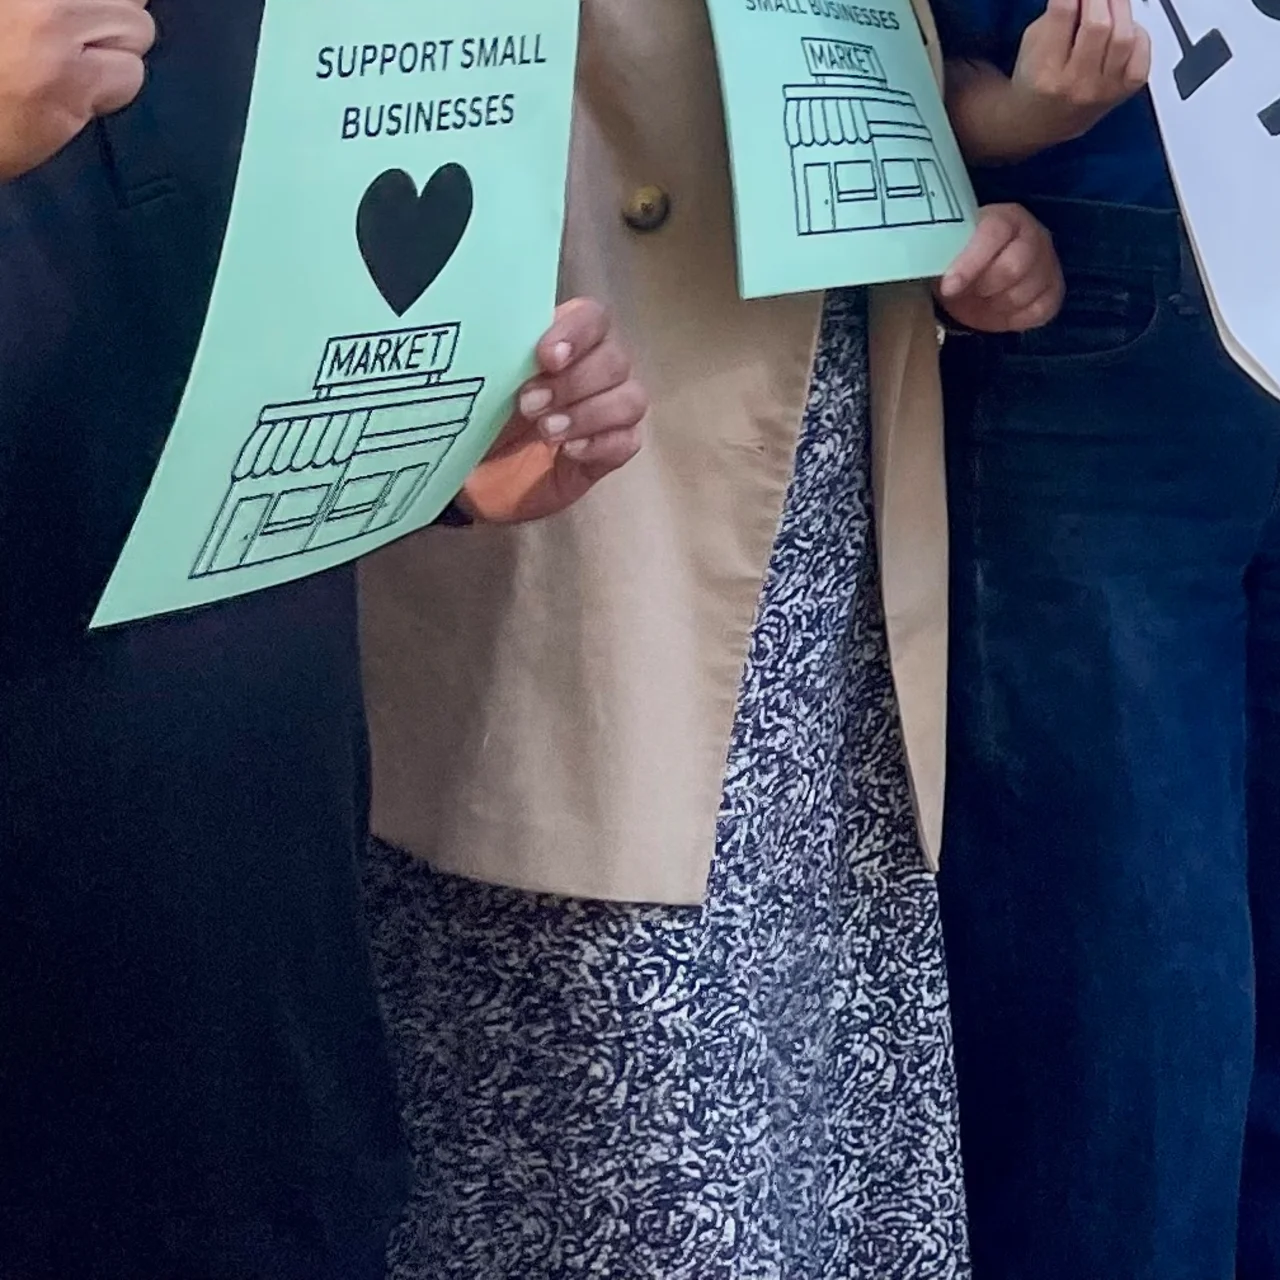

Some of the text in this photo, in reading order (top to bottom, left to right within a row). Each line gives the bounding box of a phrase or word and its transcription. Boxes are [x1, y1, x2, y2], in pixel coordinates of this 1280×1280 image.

[315, 32, 547, 80] SUPPORT SMALL
[809, 44, 877, 77] MARKET
[341, 92, 516, 140] BUSINESSES
[328, 328, 450, 379] MARKET
